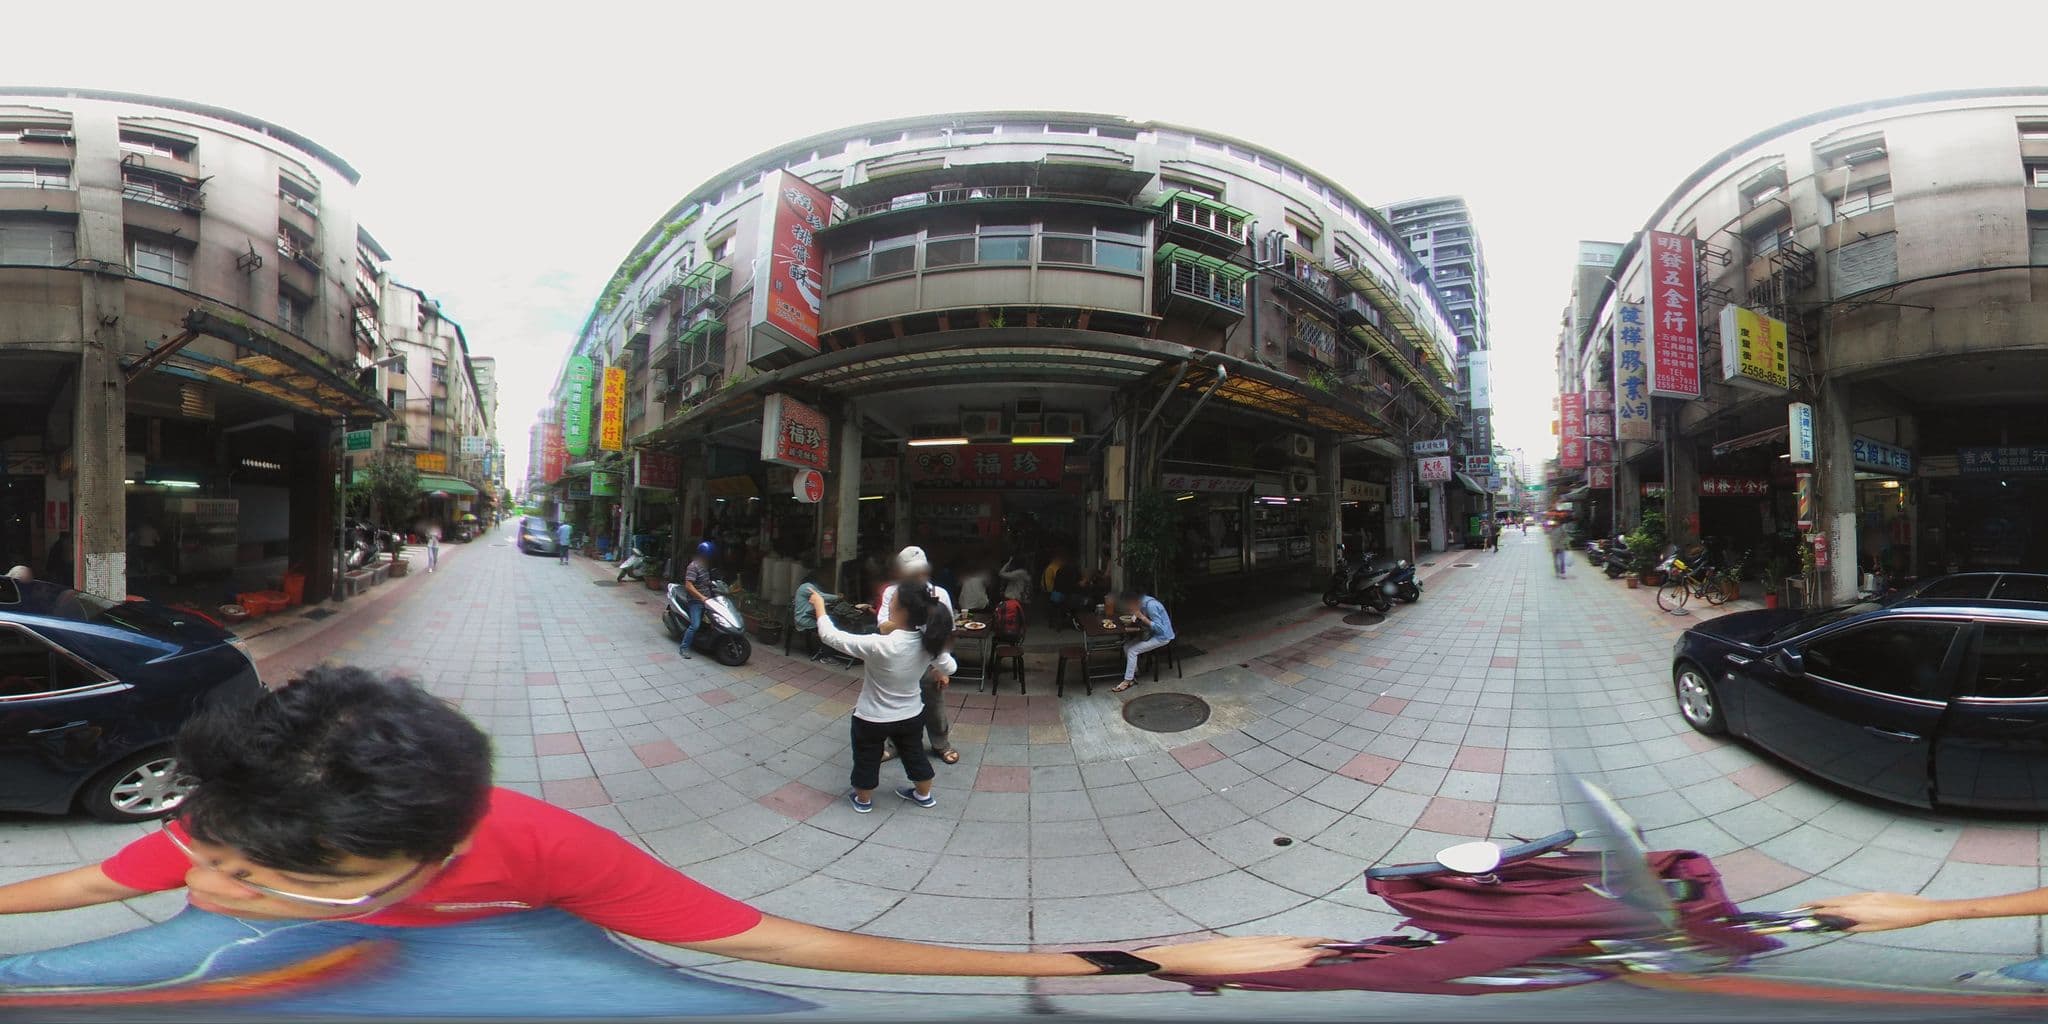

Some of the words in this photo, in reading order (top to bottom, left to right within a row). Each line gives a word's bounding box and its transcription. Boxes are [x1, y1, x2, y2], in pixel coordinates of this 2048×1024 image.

[784, 188, 827, 288] 福珍排骨酥
[1658, 238, 1689, 333] 明發五金行
[1670, 368, 1685, 377] TEL
[1741, 363, 1787, 387] 2558-8535
[789, 420, 821, 449] 福珍
[974, 450, 1040, 474] 福珍
[1424, 460, 1443, 472] 大德
